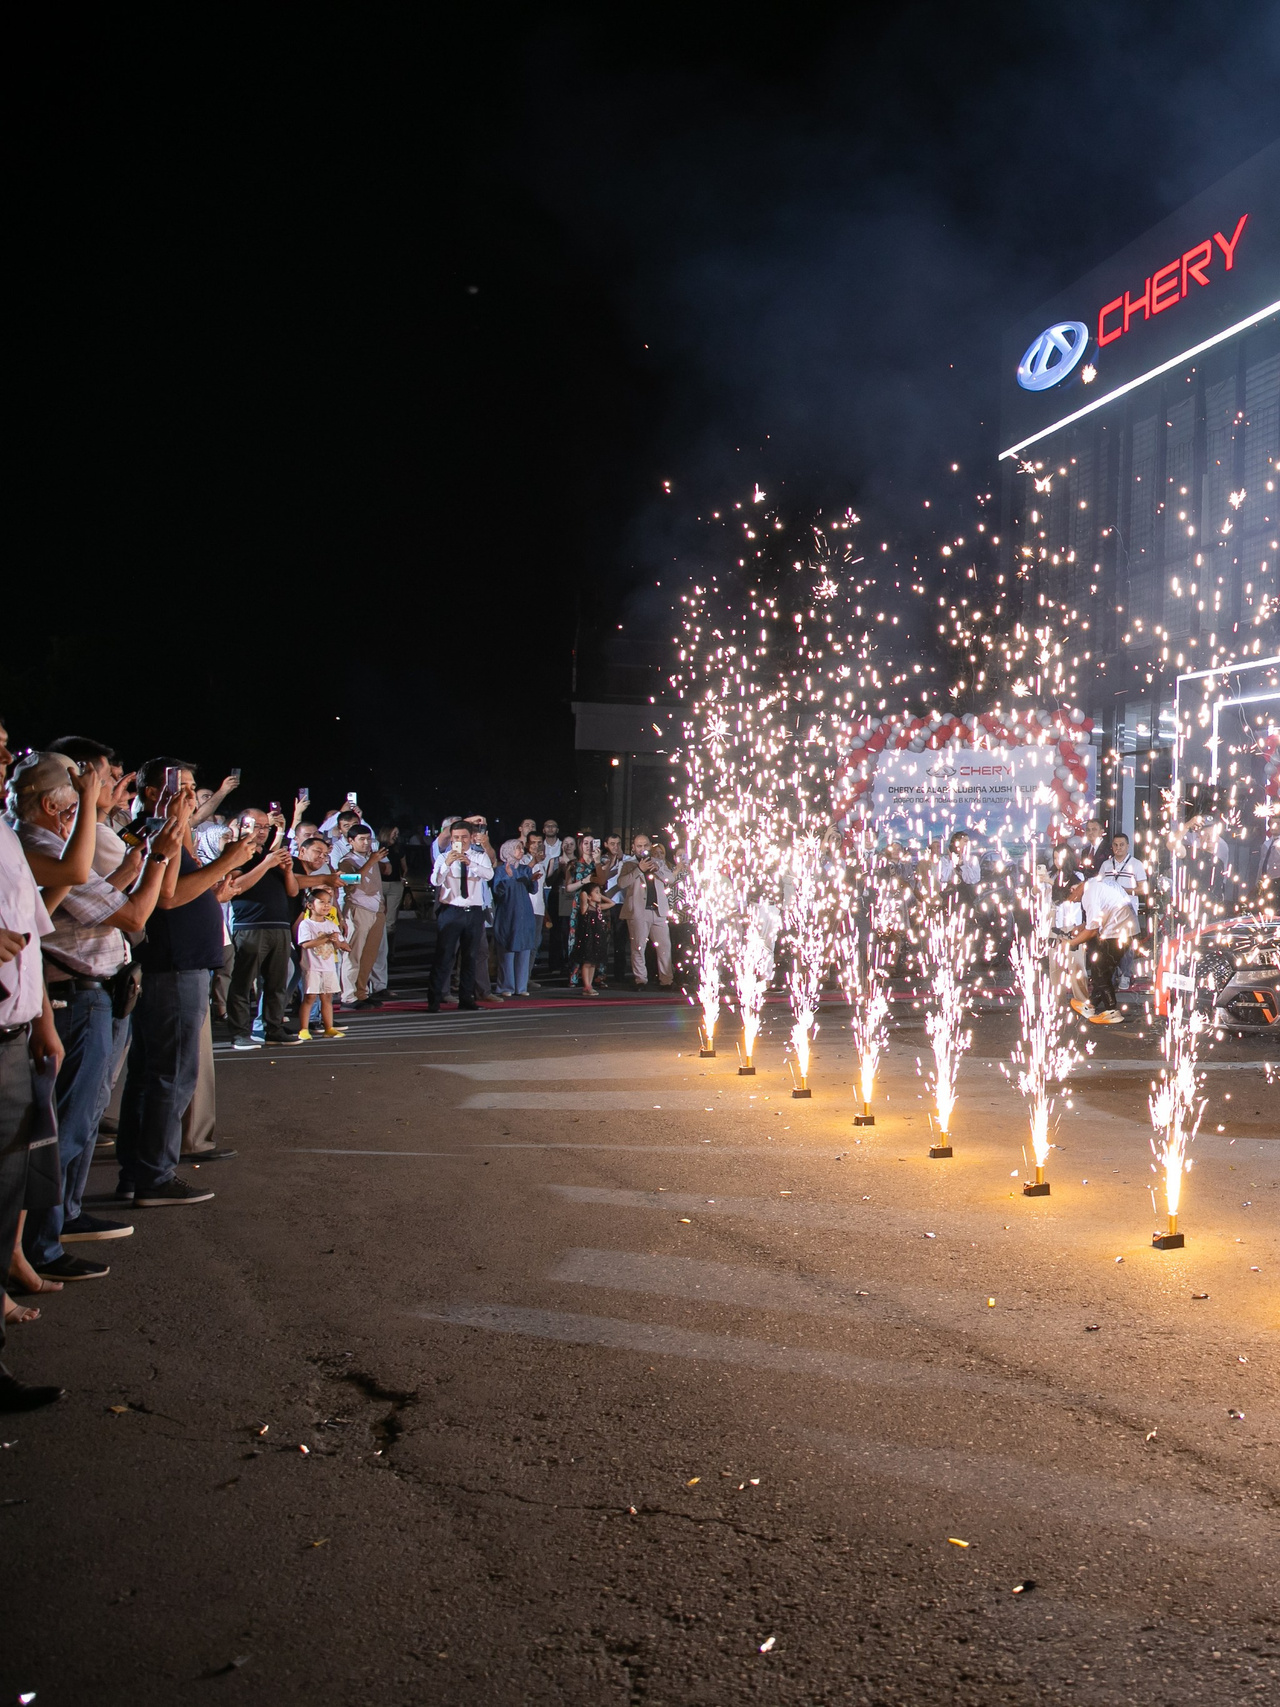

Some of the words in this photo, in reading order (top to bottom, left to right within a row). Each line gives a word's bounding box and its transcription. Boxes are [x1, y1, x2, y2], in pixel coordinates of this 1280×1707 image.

[1098, 213, 1248, 347] CHERY
[960, 765, 1013, 776] CHERY
[888, 786, 914, 794] CHERY
